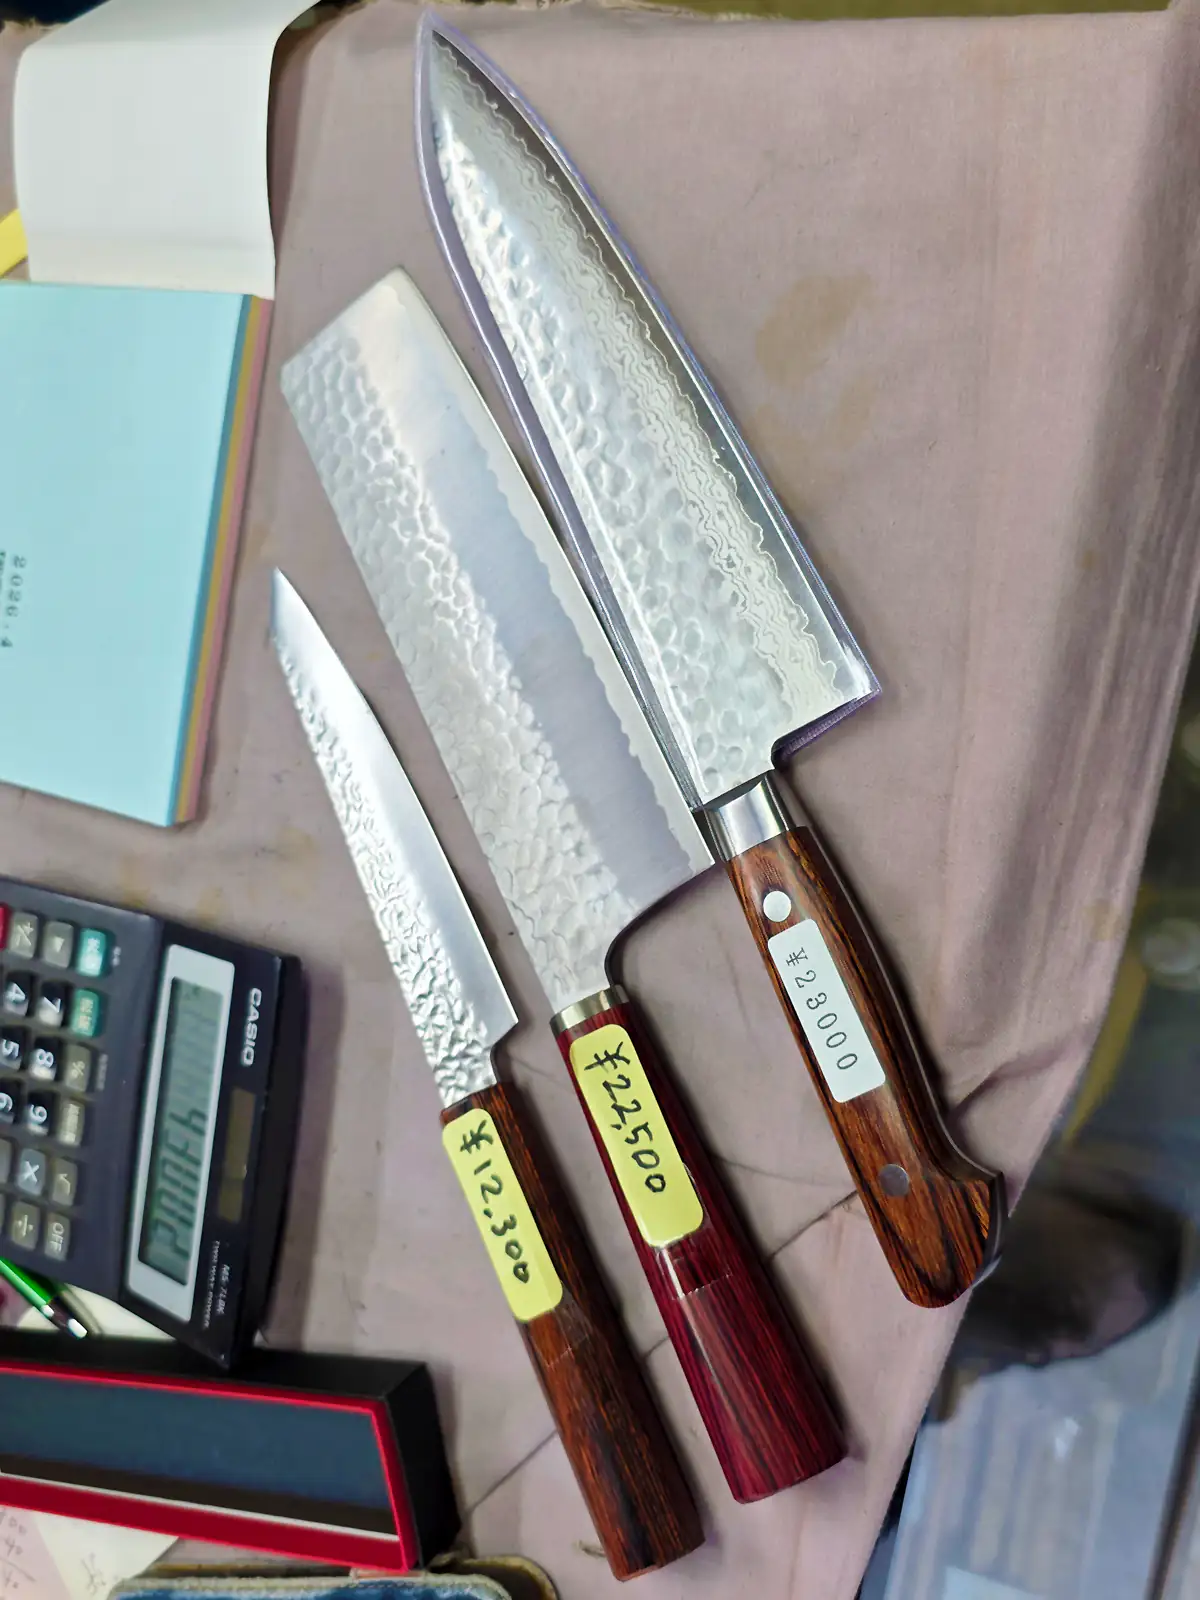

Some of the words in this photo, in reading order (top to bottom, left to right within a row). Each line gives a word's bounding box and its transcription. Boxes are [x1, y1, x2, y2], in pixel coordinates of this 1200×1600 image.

[6, 982, 26, 1003] 4
[43, 997, 61, 1014] 7
[786, 947, 858, 1070] ¥23000
[241, 987, 262, 1067] CASIO
[36, 1048, 54, 1068] 8
[30, 1104, 48, 1125] 9
[584, 1041, 667, 1193] ¥22,500
[50, 1222, 64, 1252] OFF
